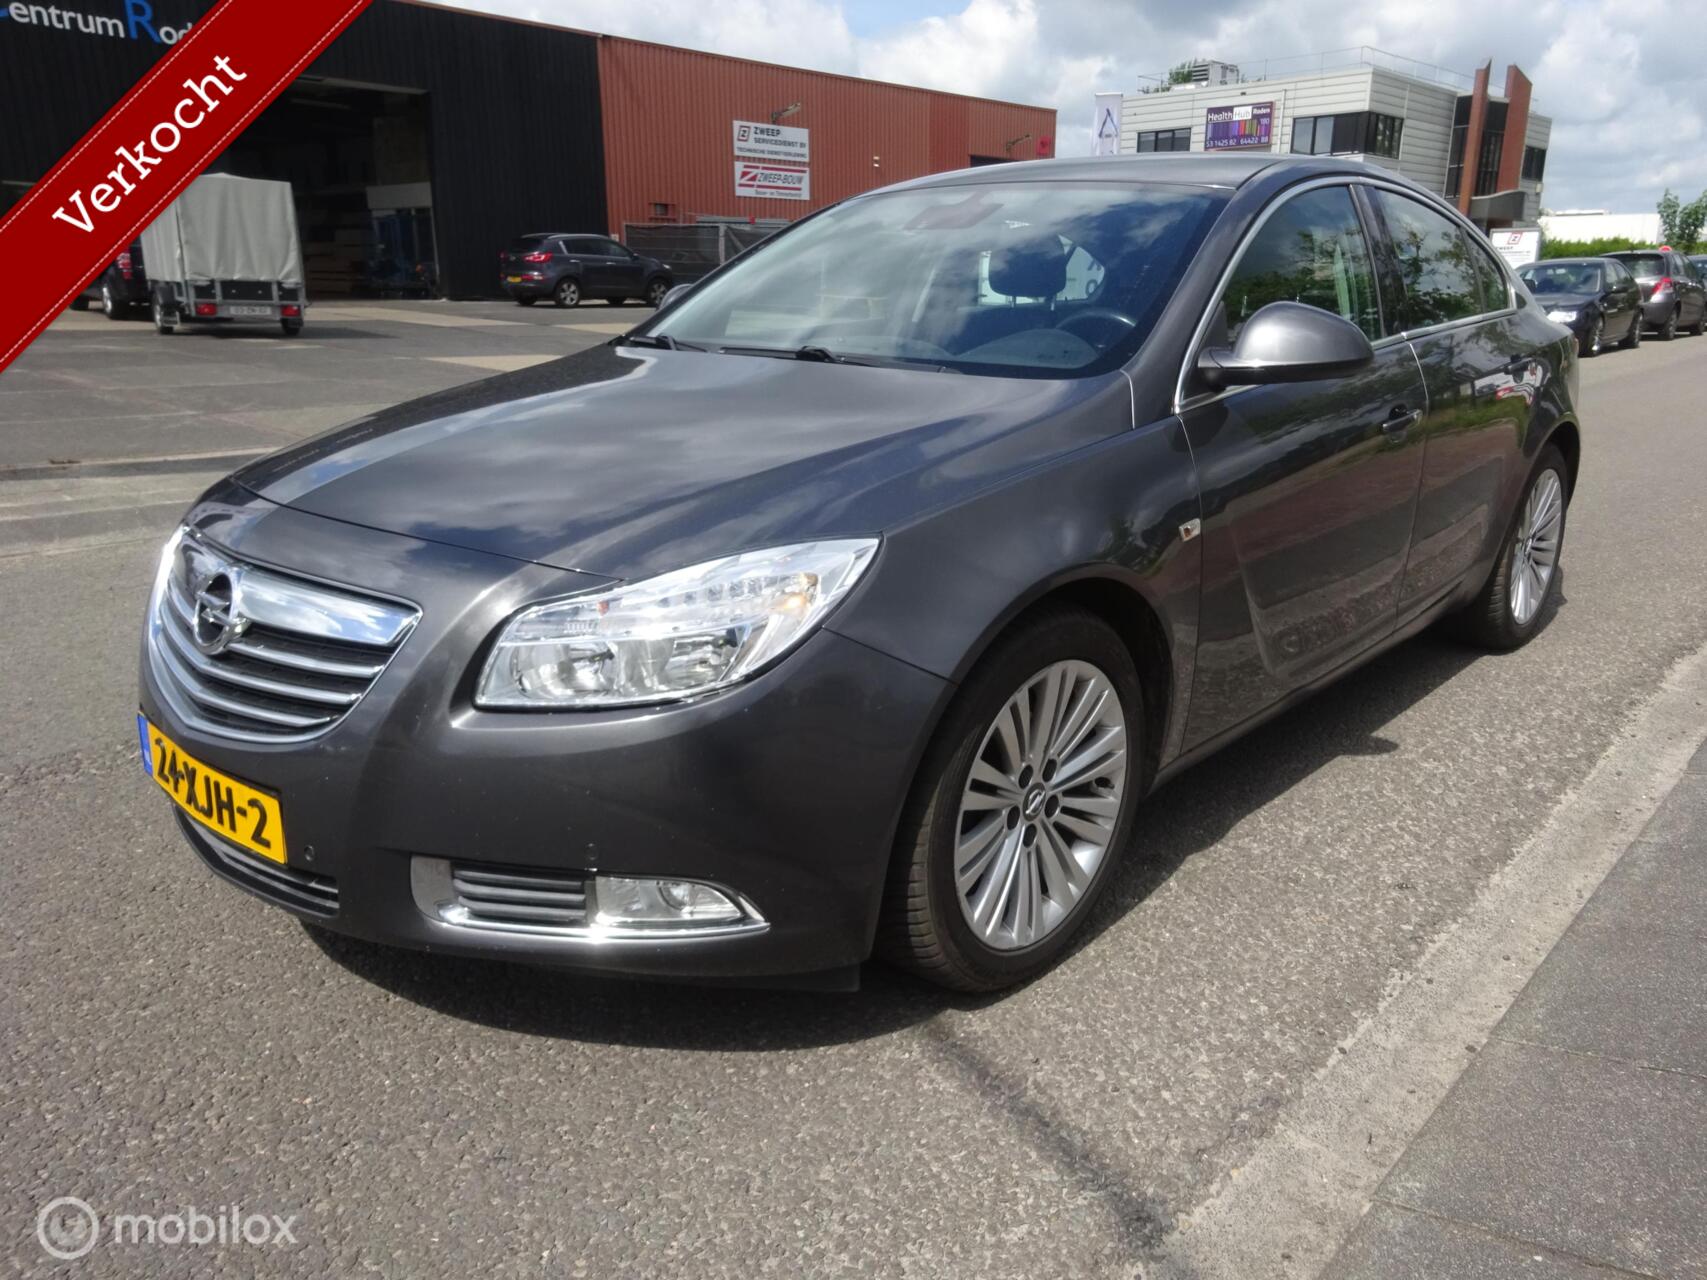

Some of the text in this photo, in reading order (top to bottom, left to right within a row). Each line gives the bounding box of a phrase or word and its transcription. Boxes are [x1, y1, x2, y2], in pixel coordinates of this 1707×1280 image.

[0, 1, 126, 39] entrum
[1207, 112, 1233, 121] Health
[753, 126, 781, 137] ZWEEP
[753, 137, 798, 147] SERVICEDIENST
[757, 172, 804, 185] ZWEEP-BOUW
[154, 737, 272, 849] 24-XJH-2
